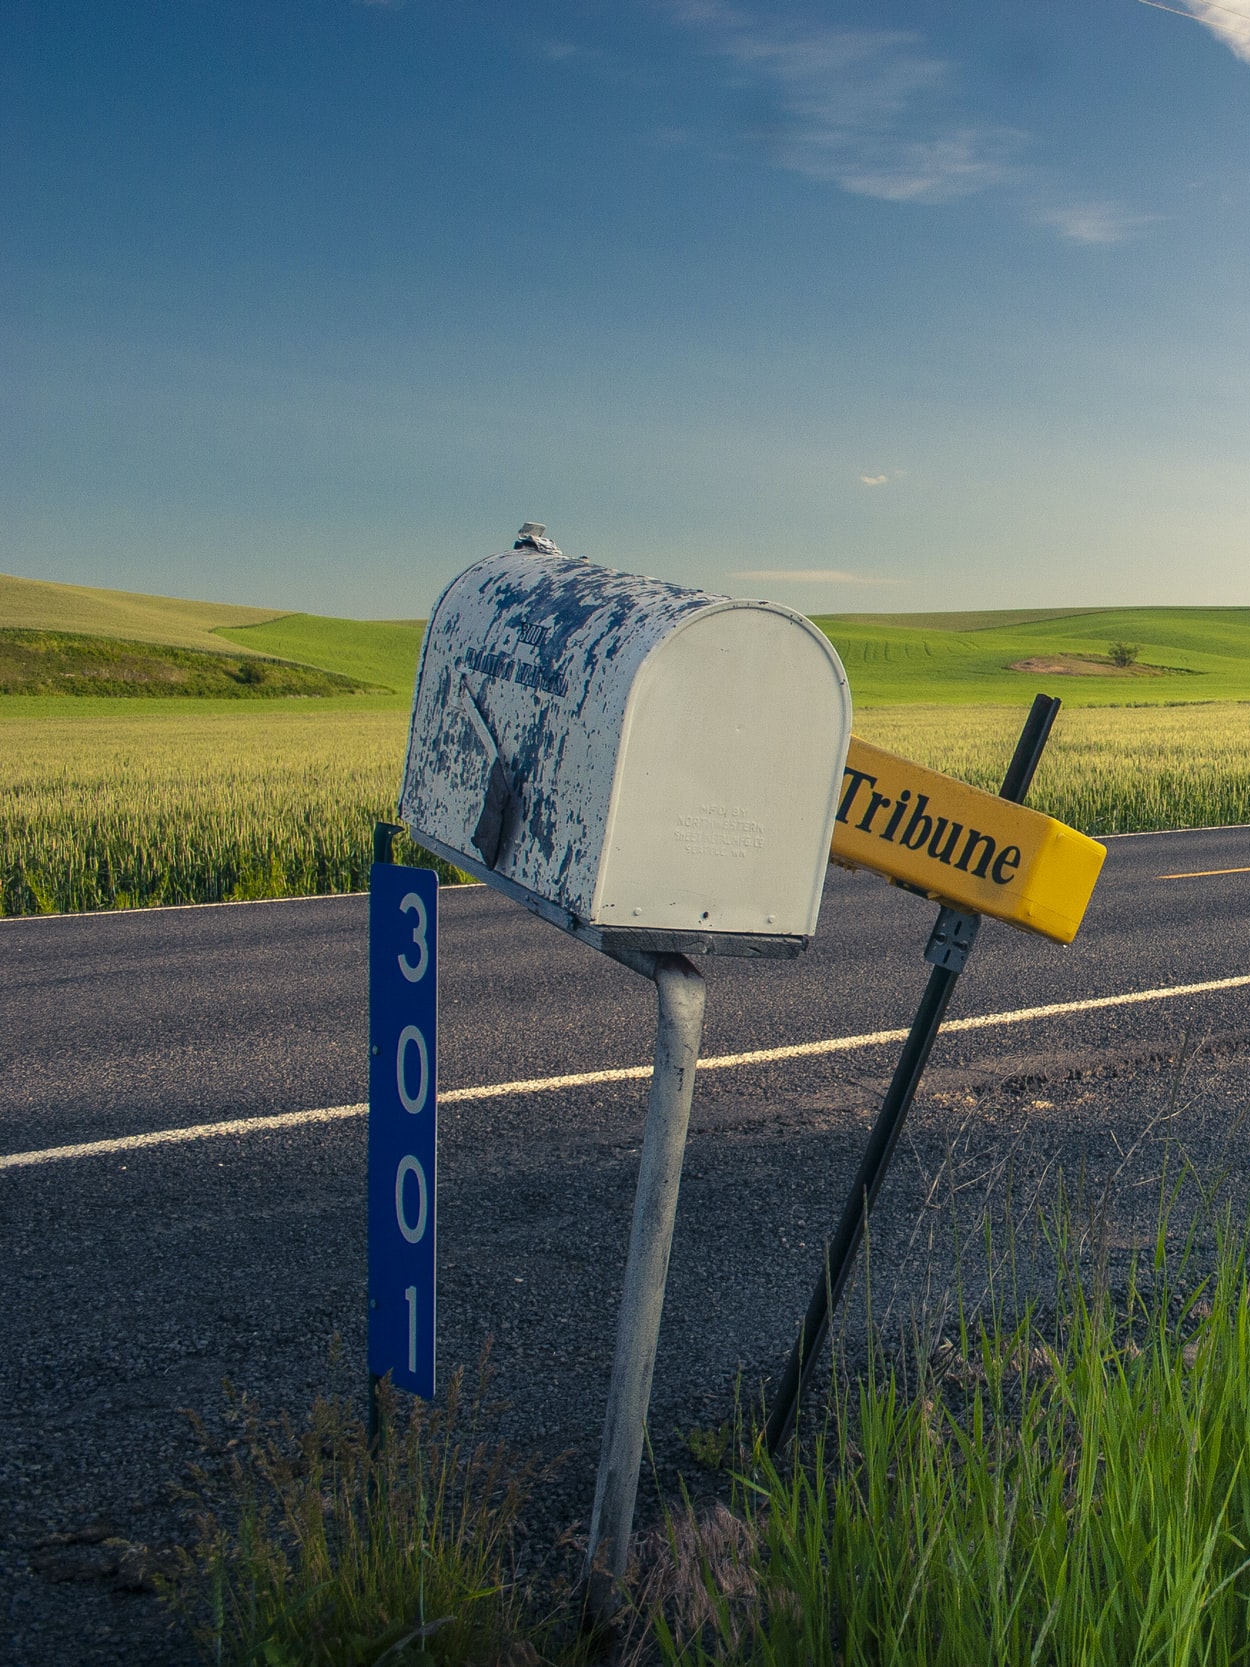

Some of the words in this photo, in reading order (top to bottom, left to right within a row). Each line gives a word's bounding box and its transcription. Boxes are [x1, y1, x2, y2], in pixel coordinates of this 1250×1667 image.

[519, 622, 547, 646] 3001
[836, 766, 1021, 885] Tribune
[395, 892, 429, 1373] 3001
